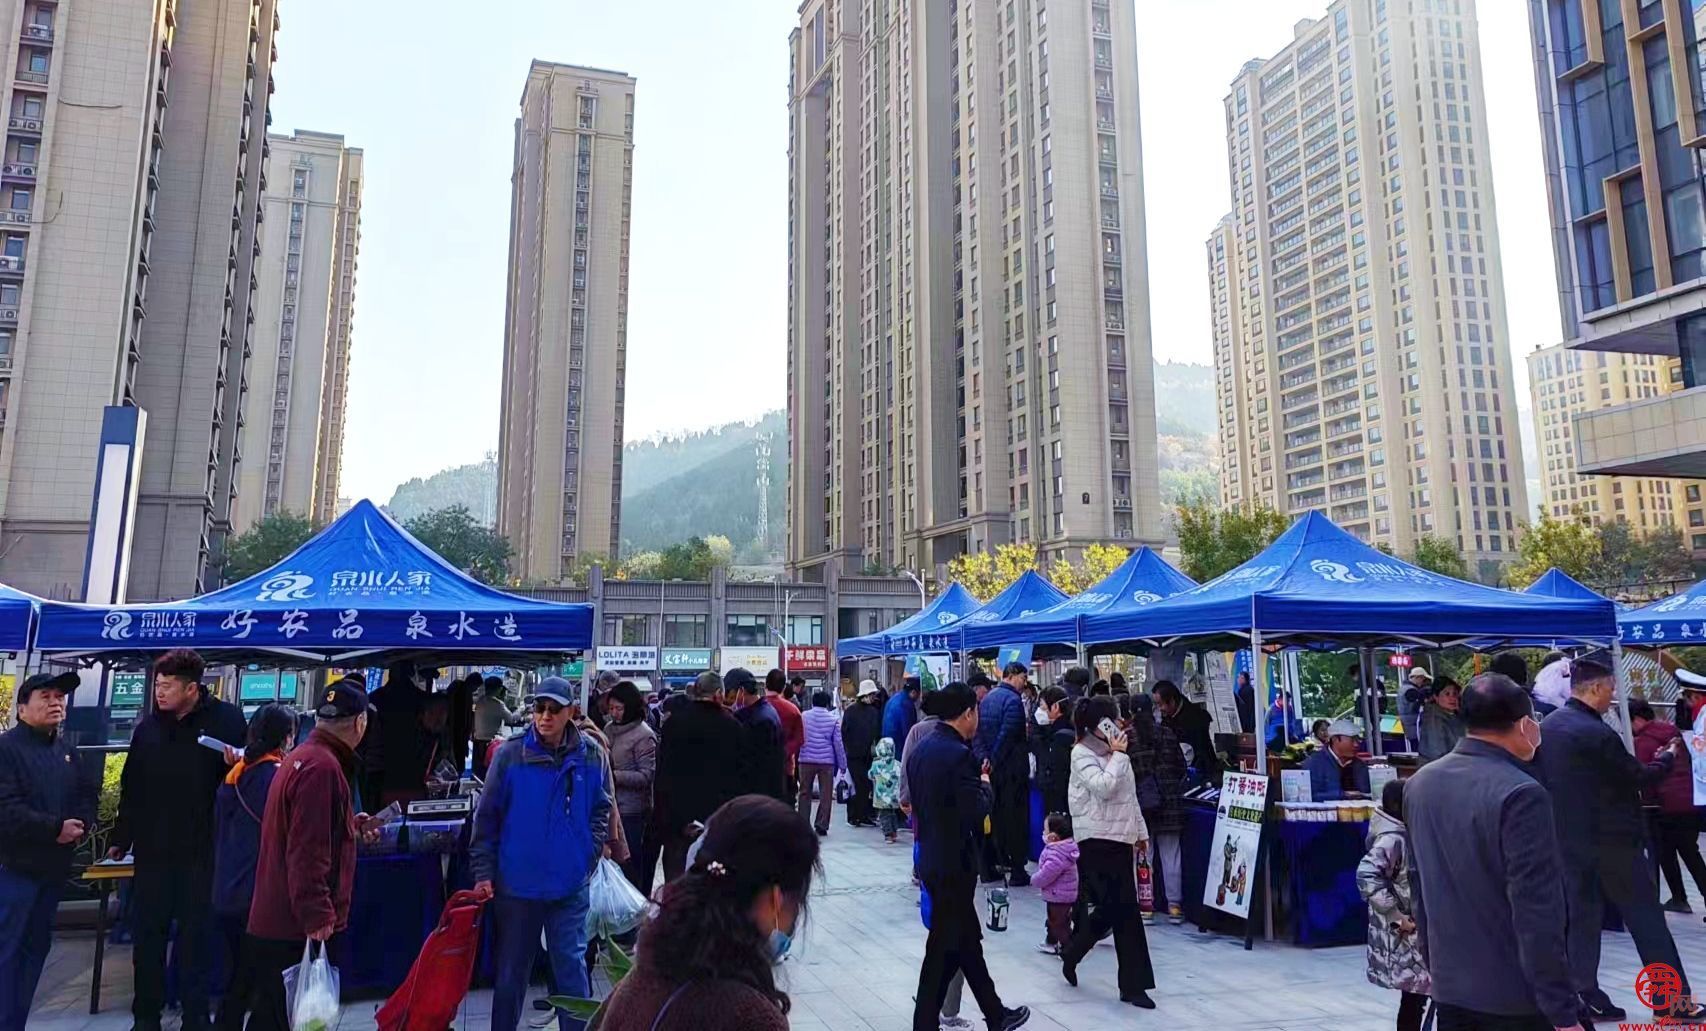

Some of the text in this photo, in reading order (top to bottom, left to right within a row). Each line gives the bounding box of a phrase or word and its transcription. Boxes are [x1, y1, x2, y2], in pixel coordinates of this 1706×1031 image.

[331, 570, 432, 587] 泉水人家
[140, 611, 197, 628] 泉水人家
[114, 681, 144, 695] 五金
